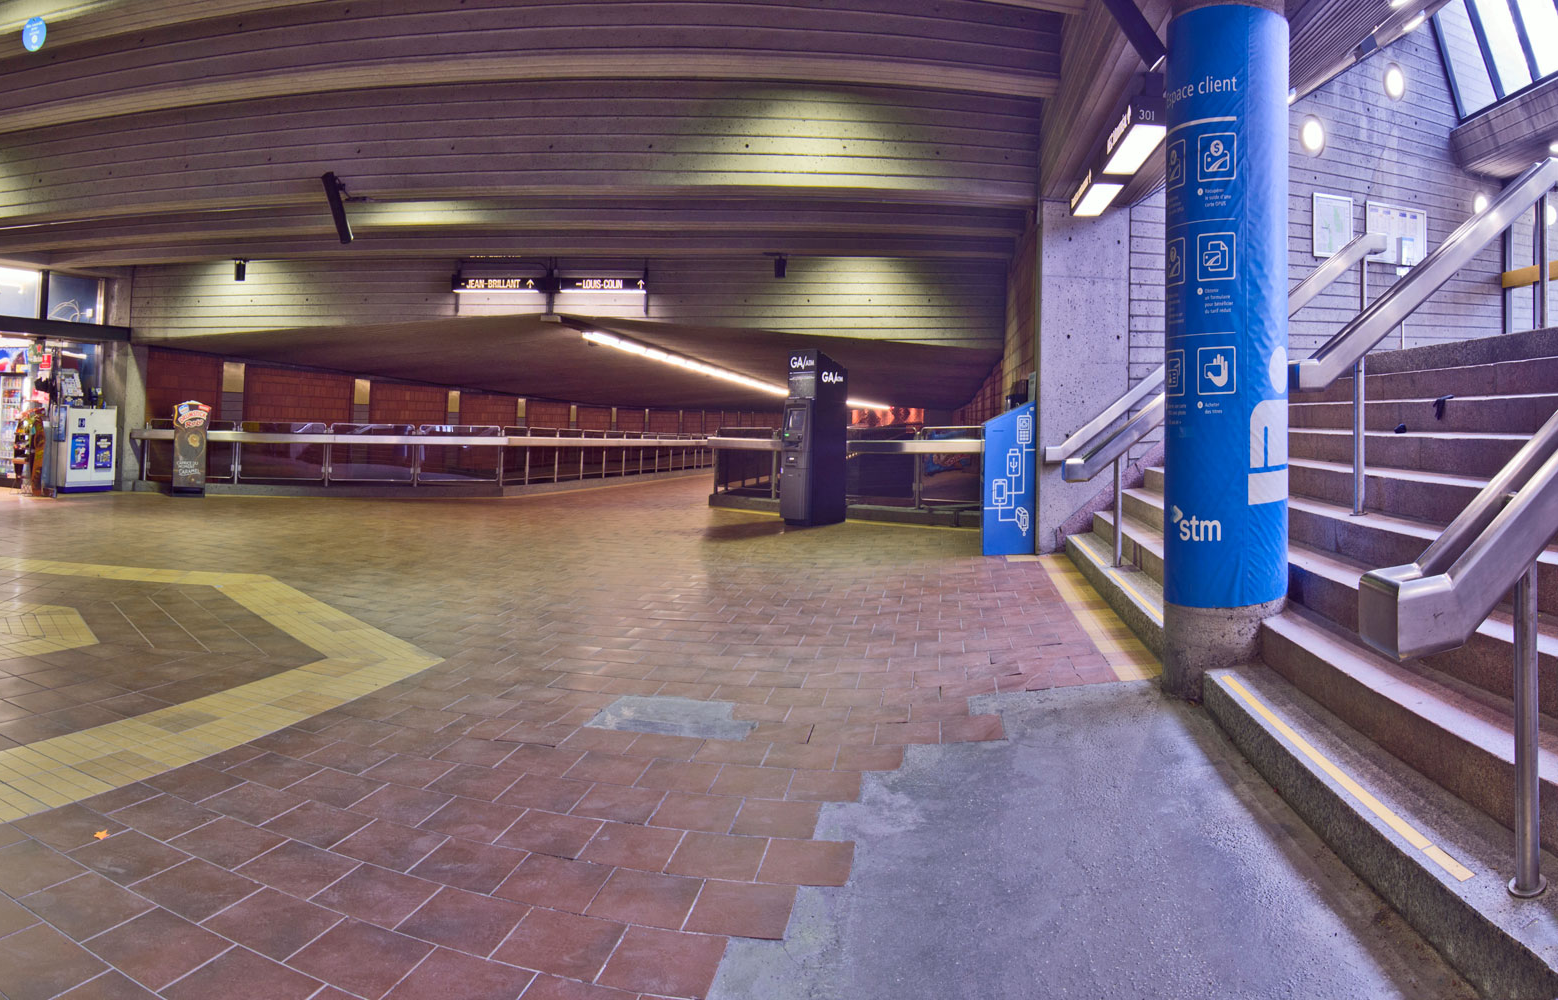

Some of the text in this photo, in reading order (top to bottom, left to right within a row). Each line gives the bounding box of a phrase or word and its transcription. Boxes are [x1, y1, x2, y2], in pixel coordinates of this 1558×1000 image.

[1198, 75, 1237, 94] client
[1138, 109, 1155, 121] 301
[466, 279, 521, 289] JEAN-BRILLANT
[582, 279, 623, 289] LOUIS-COLIN
[1179, 514, 1222, 542] stm
